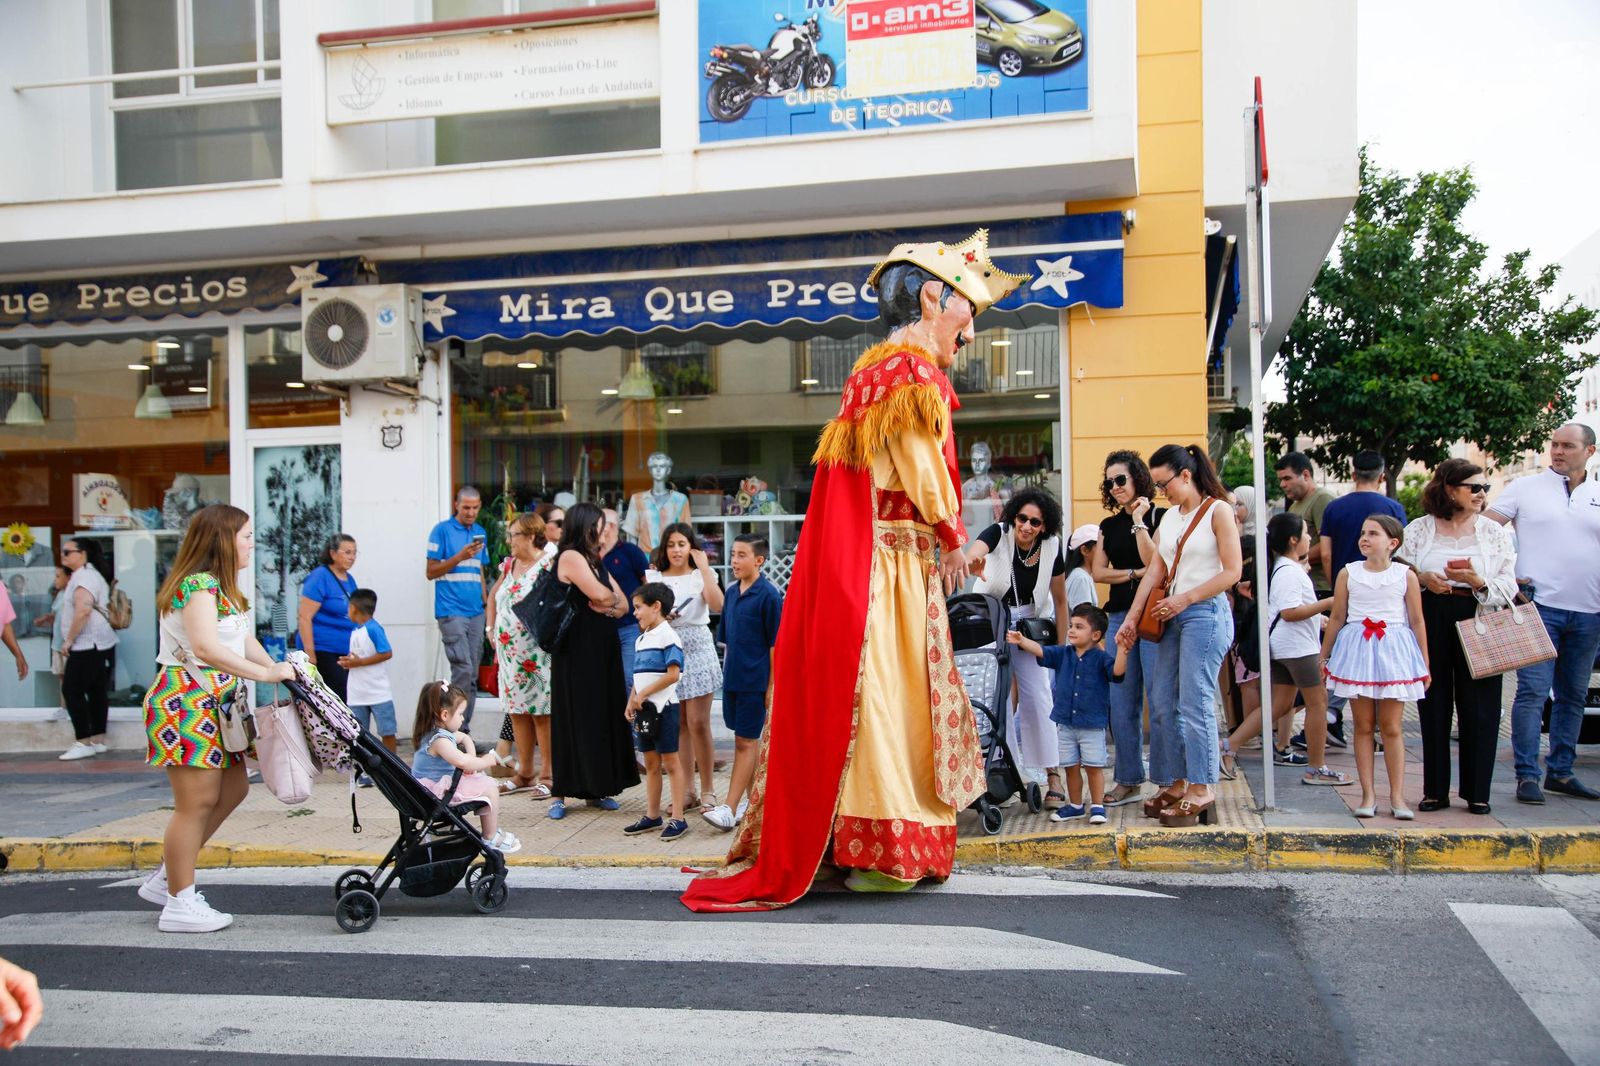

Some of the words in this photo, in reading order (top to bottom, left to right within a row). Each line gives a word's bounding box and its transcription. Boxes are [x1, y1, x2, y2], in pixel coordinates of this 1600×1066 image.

[884, 23, 919, 33] servicios
[521, 37, 578, 52] Oposiciones
[576, 58, 619, 72] On-Line
[442, 73, 455, 83] de
[587, 83, 600, 94] de
[406, 97, 445, 110] Idiomas
[831, 107, 857, 123] DE
[864, 99, 953, 120] TEORICA
[0, 292, 49, 314] ue
[77, 275, 248, 310] Precios
[499, 293, 615, 323] Mira
[644, 286, 734, 322] Que
